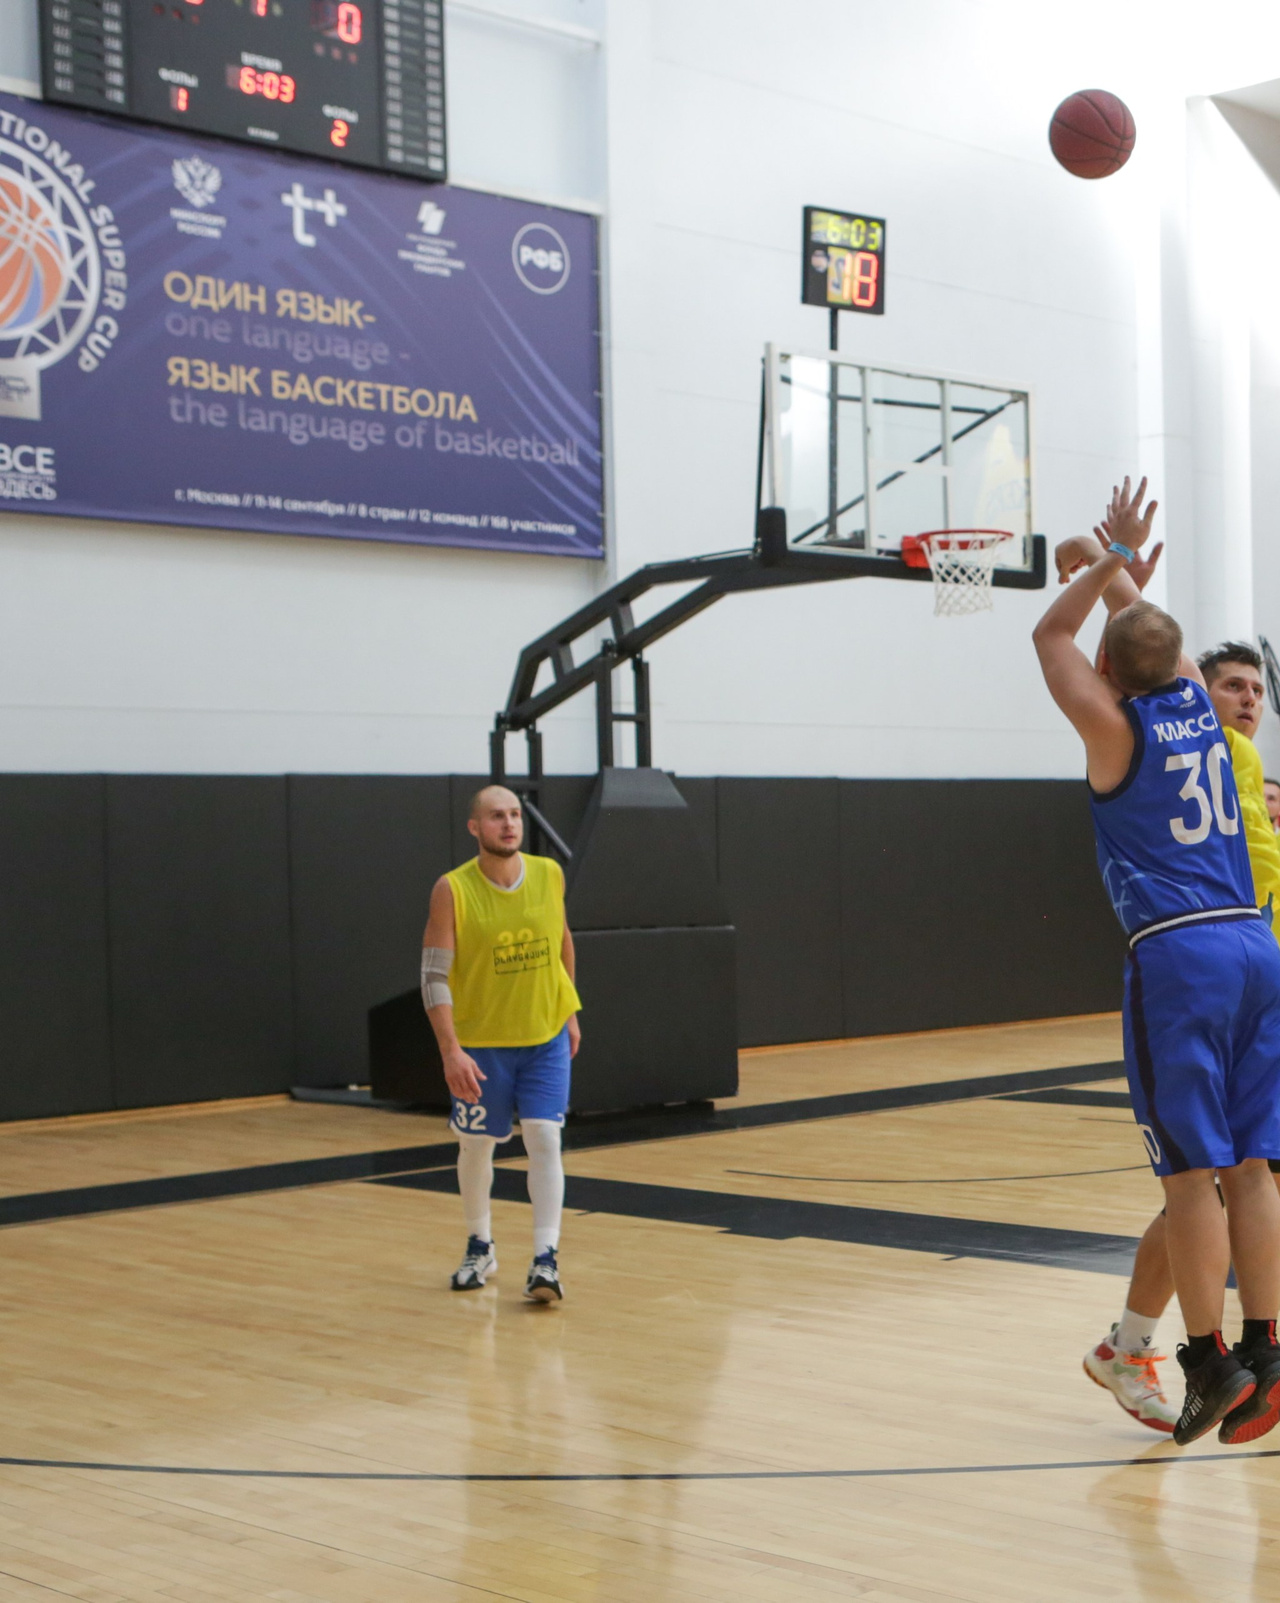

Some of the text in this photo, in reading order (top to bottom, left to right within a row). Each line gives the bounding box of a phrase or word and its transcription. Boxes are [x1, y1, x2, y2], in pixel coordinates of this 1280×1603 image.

[337, 2, 362, 44] 0
[176, 87, 189, 111] 1
[239, 66, 296, 103] 6:03
[330, 119, 349, 147] 2
[827, 214, 883, 251] 6:03
[89, 204, 127, 311] SUPER
[519, 244, 564, 272] РФБ
[163, 271, 267, 315] ОДИН
[78, 315, 119, 373] CUP
[165, 312, 233, 343] one
[242, 314, 390, 371] language
[167, 356, 479, 423] ЯЗЫК БАСКЕТБОЛА
[169, 390, 580, 467] the language of basketball
[0, 478, 57, 500] ДЕСЬ
[187, 488, 240, 507] Москва
[283, 499, 346, 517] сентября
[368, 506, 406, 522] стран
[418, 509, 431, 523] 12
[432, 511, 479, 528] команд
[510, 517, 577, 536] участников
[1152, 708, 1218, 743] КЛАСС
[1164, 742, 1239, 845] 30
[455, 1102, 487, 1130] 32
